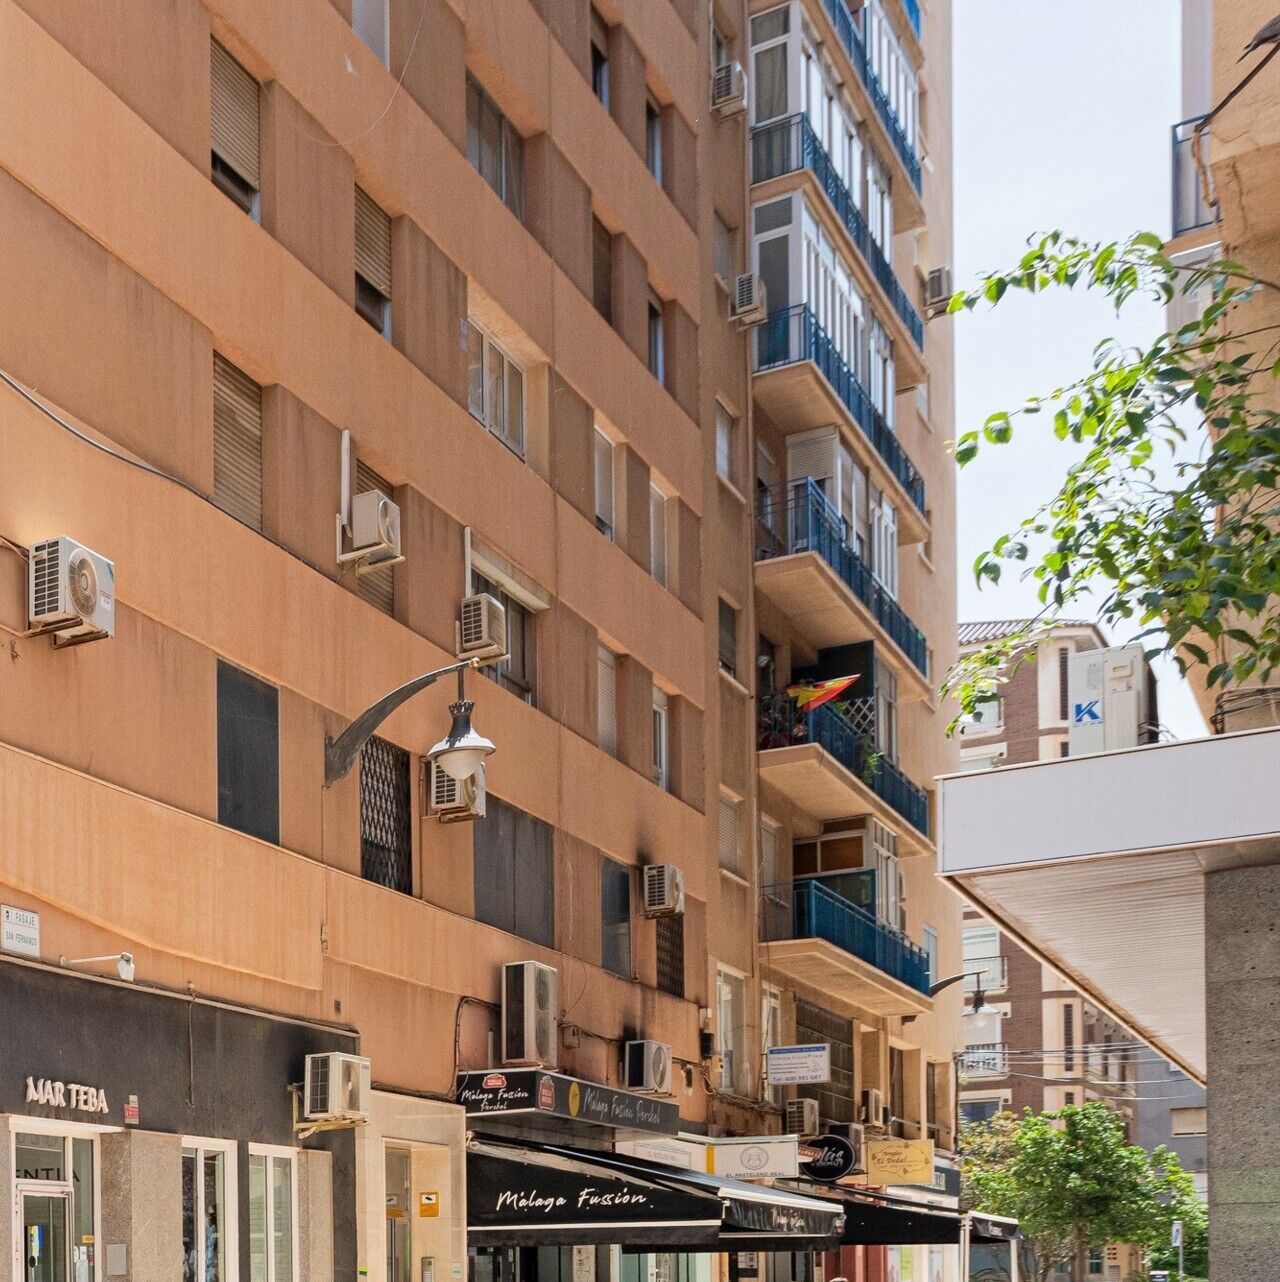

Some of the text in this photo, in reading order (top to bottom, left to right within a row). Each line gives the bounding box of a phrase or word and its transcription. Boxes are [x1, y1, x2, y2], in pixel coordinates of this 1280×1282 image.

[15, 912, 35, 926] PASAJE
[6, 931, 37, 947] SAN FERNANDO
[26, 1076, 66, 1107] MAR
[67, 1083, 109, 1114] TEBA
[496, 1190, 566, 1212] Málaga
